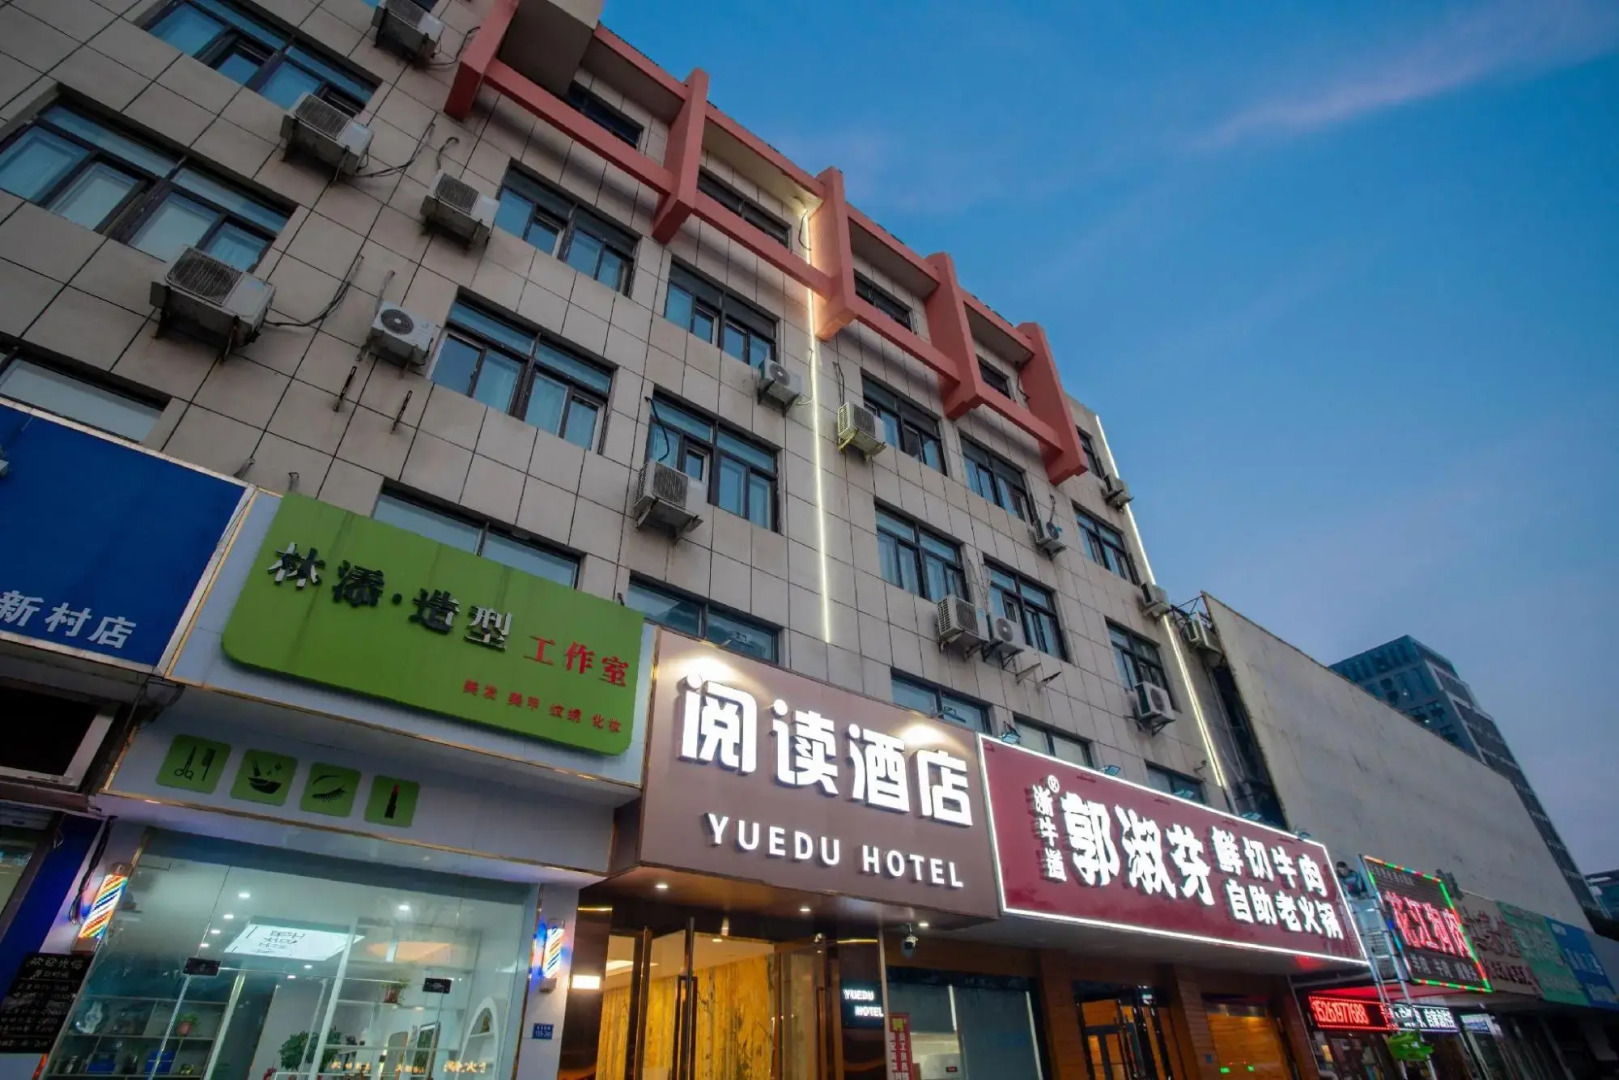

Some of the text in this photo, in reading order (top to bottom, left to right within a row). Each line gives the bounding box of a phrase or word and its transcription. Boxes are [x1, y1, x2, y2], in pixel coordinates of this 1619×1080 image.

[0, 590, 137, 649] 新村店
[523, 636, 630, 688] 工作室
[678, 673, 974, 827] 阅读酒店
[704, 812, 965, 889] YUEDU HOTEL
[1060, 790, 1216, 906] 郭淑芬
[1211, 825, 1329, 898] 鲜切牛肉
[1225, 878, 1345, 941] 自助老火锅
[842, 988, 875, 1001] YUEDU
[854, 1005, 885, 1018] HOTEL
